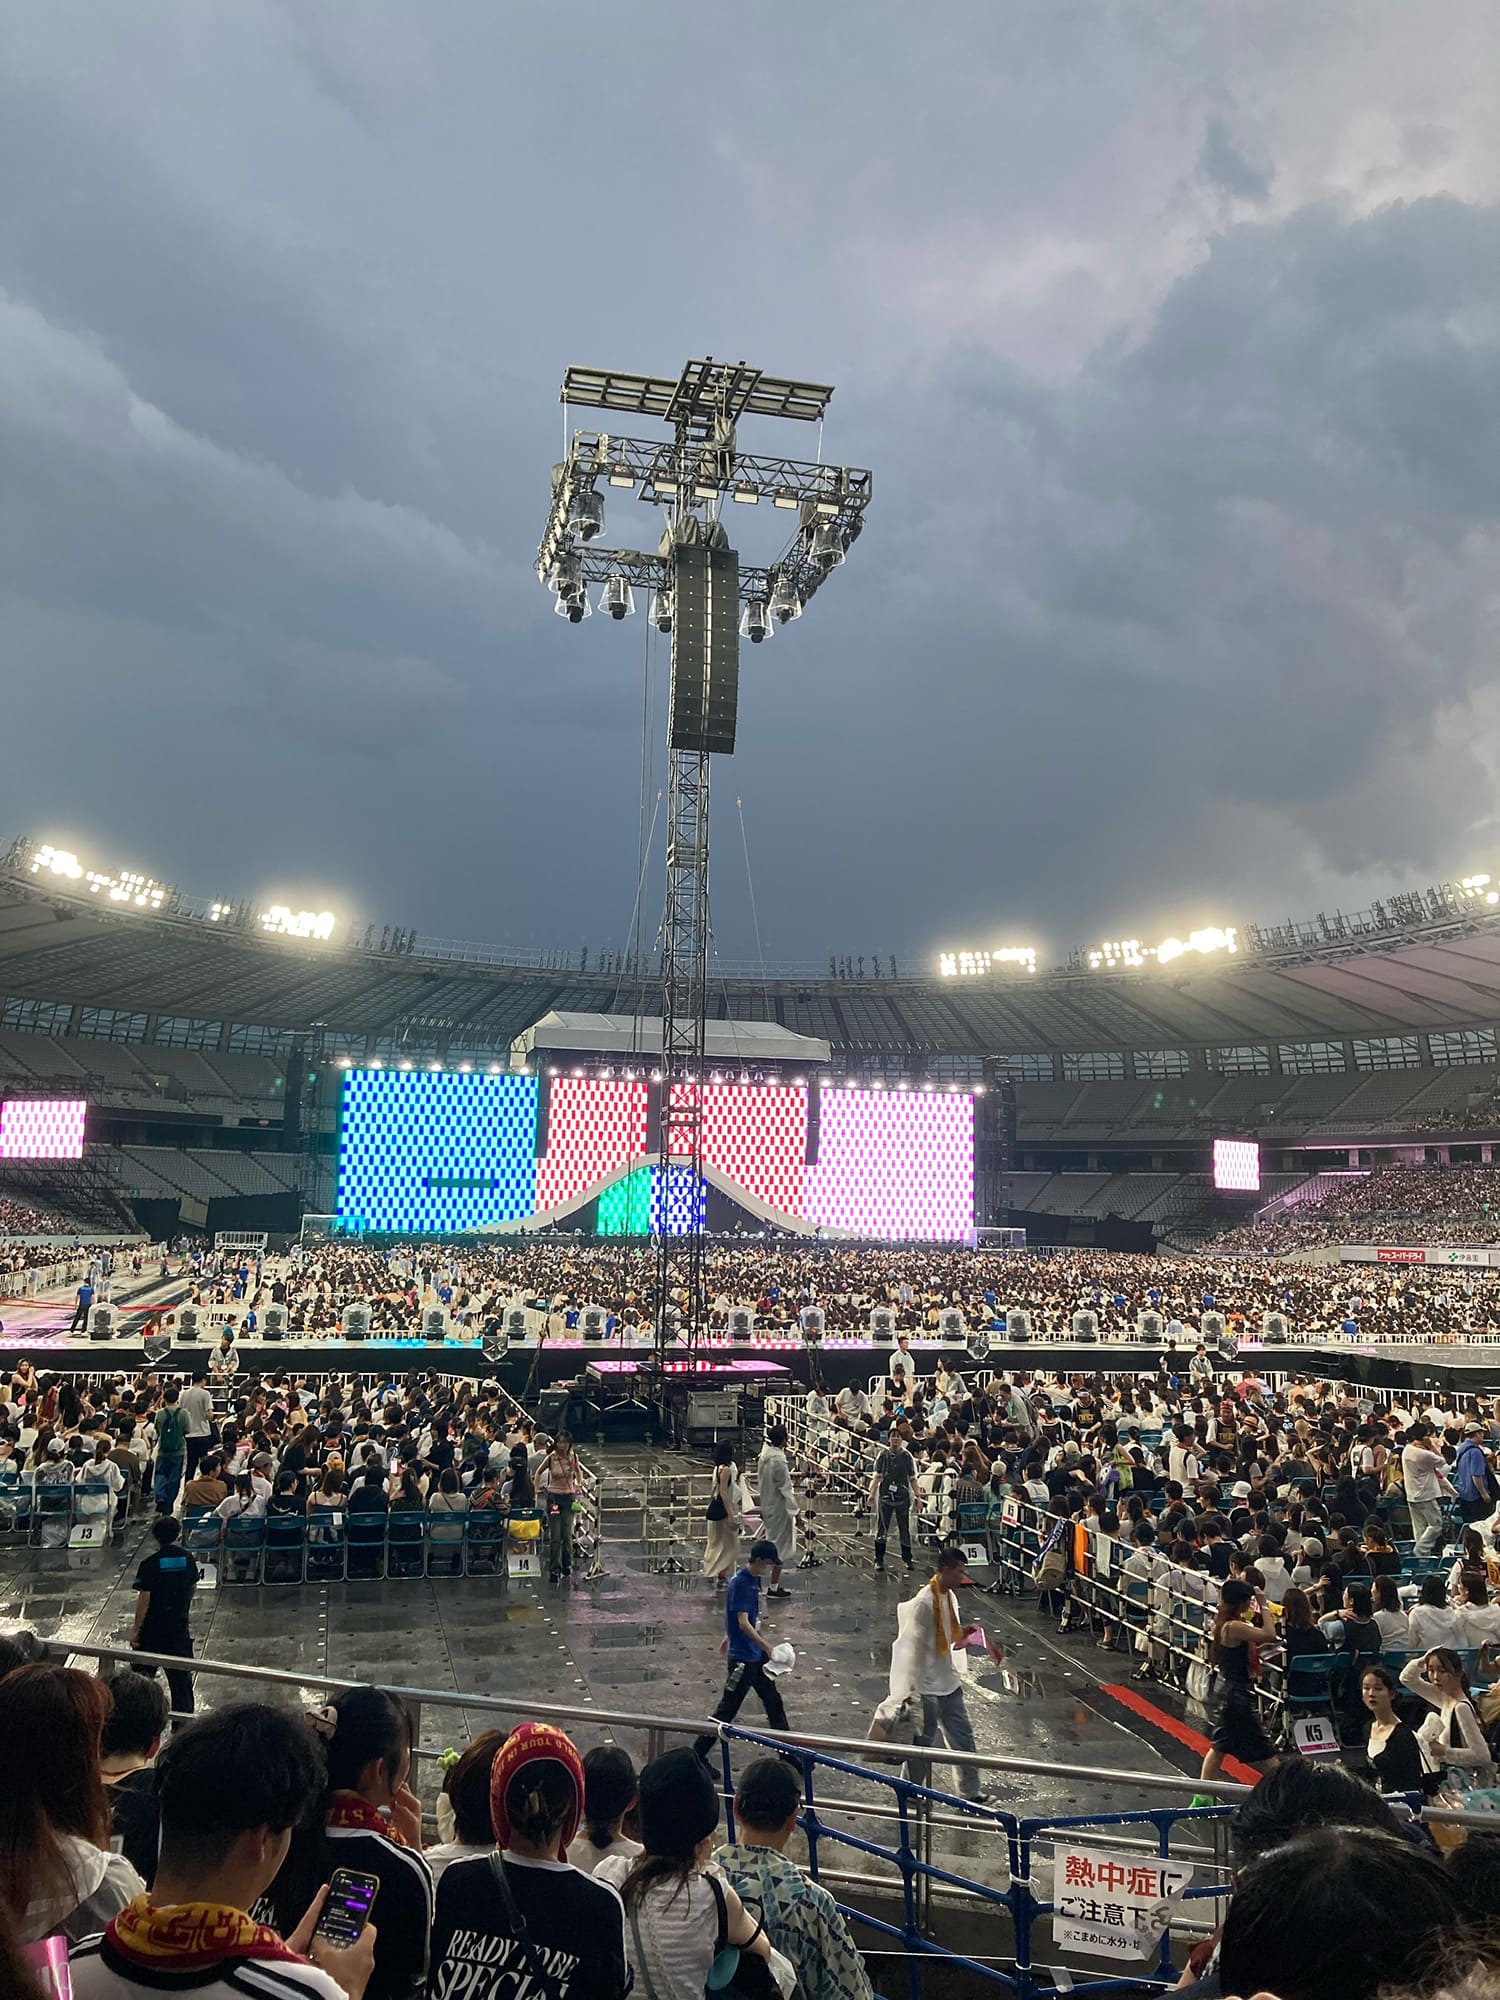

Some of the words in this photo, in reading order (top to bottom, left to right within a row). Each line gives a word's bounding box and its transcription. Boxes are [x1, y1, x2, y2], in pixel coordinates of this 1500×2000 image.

[521, 1737, 552, 1751] TOUR
[1305, 1724, 1323, 1742] K5
[1065, 1856, 1182, 1898] 熱中症に
[446, 1929, 519, 1966] READY
[547, 1950, 580, 1981] BE
